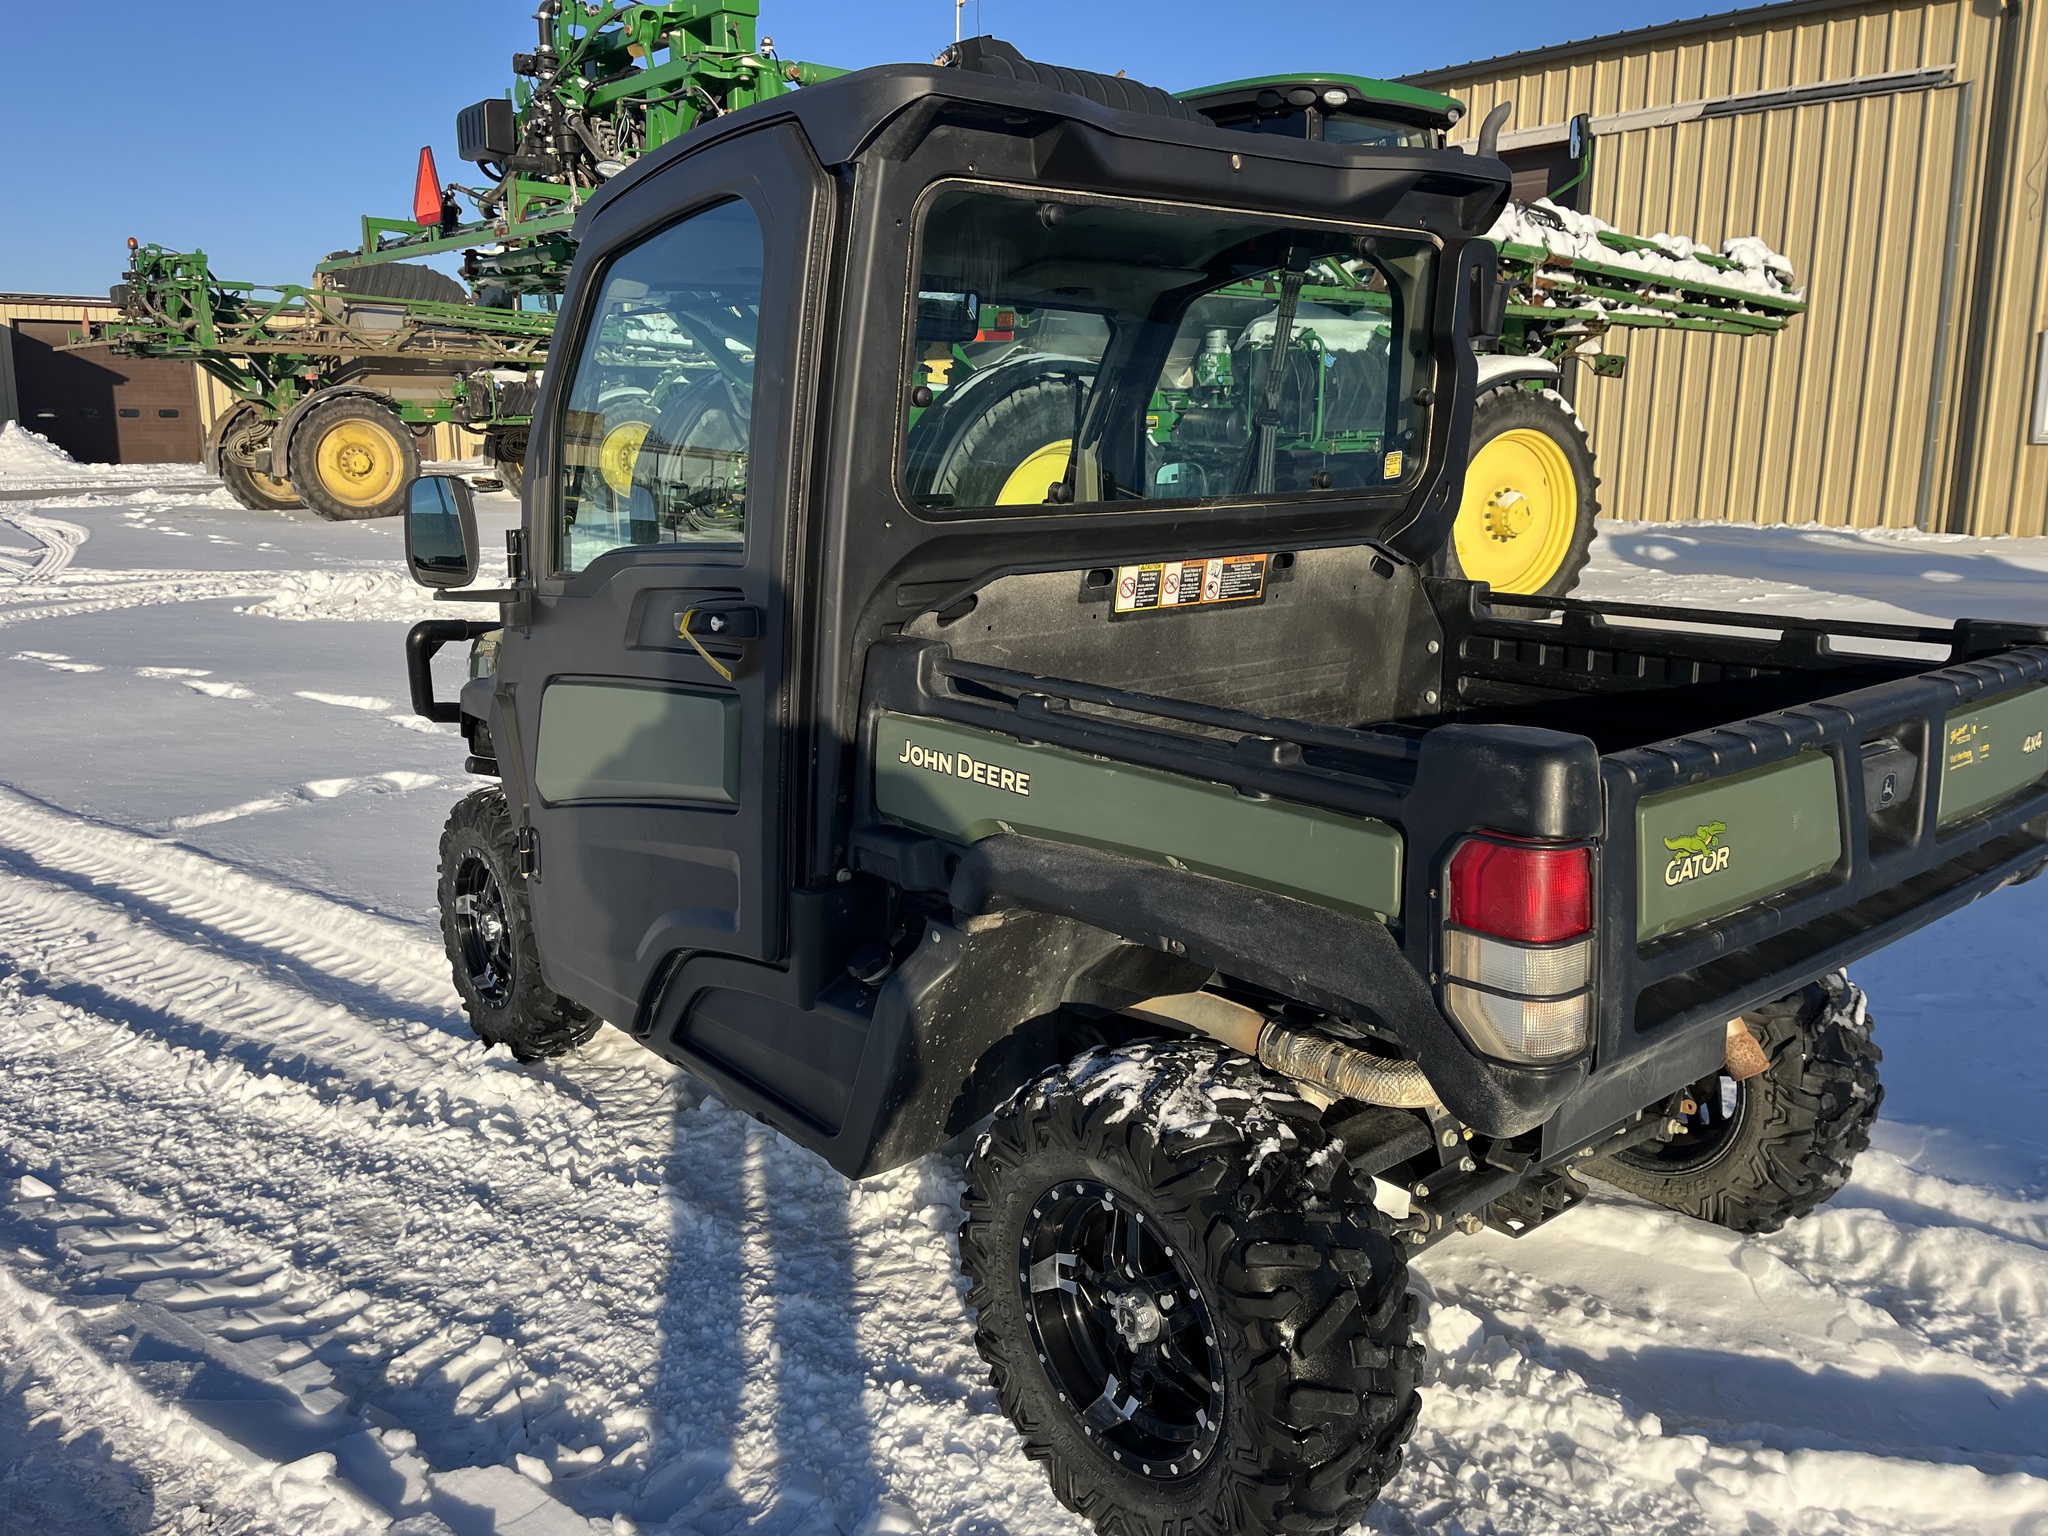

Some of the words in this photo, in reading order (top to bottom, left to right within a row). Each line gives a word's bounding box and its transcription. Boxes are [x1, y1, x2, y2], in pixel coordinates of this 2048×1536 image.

[899, 739, 953, 775] JOHN
[956, 752, 1031, 797] DEERE
[1665, 846, 1730, 887] GATOR
